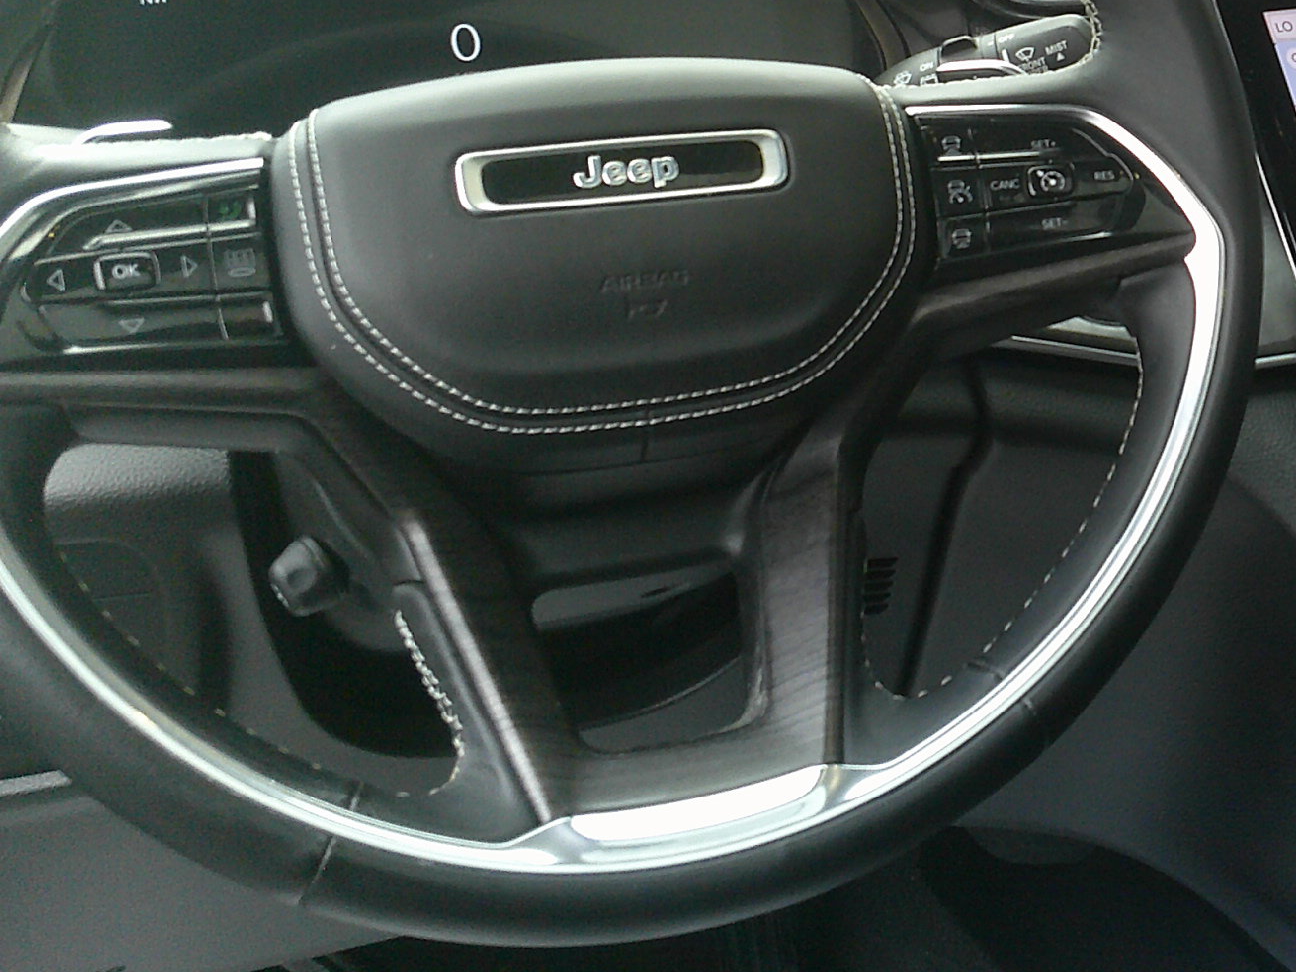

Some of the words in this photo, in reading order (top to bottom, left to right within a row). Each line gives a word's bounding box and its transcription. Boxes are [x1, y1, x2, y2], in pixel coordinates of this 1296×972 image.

[1275, 20, 1293, 33] LO
[450, 23, 482, 62] 0
[1045, 40, 1068, 55] MIST
[573, 155, 680, 188] Jeep
[1093, 170, 1115, 180] RES
[990, 178, 1020, 191] CANC
[111, 262, 142, 279] OK
